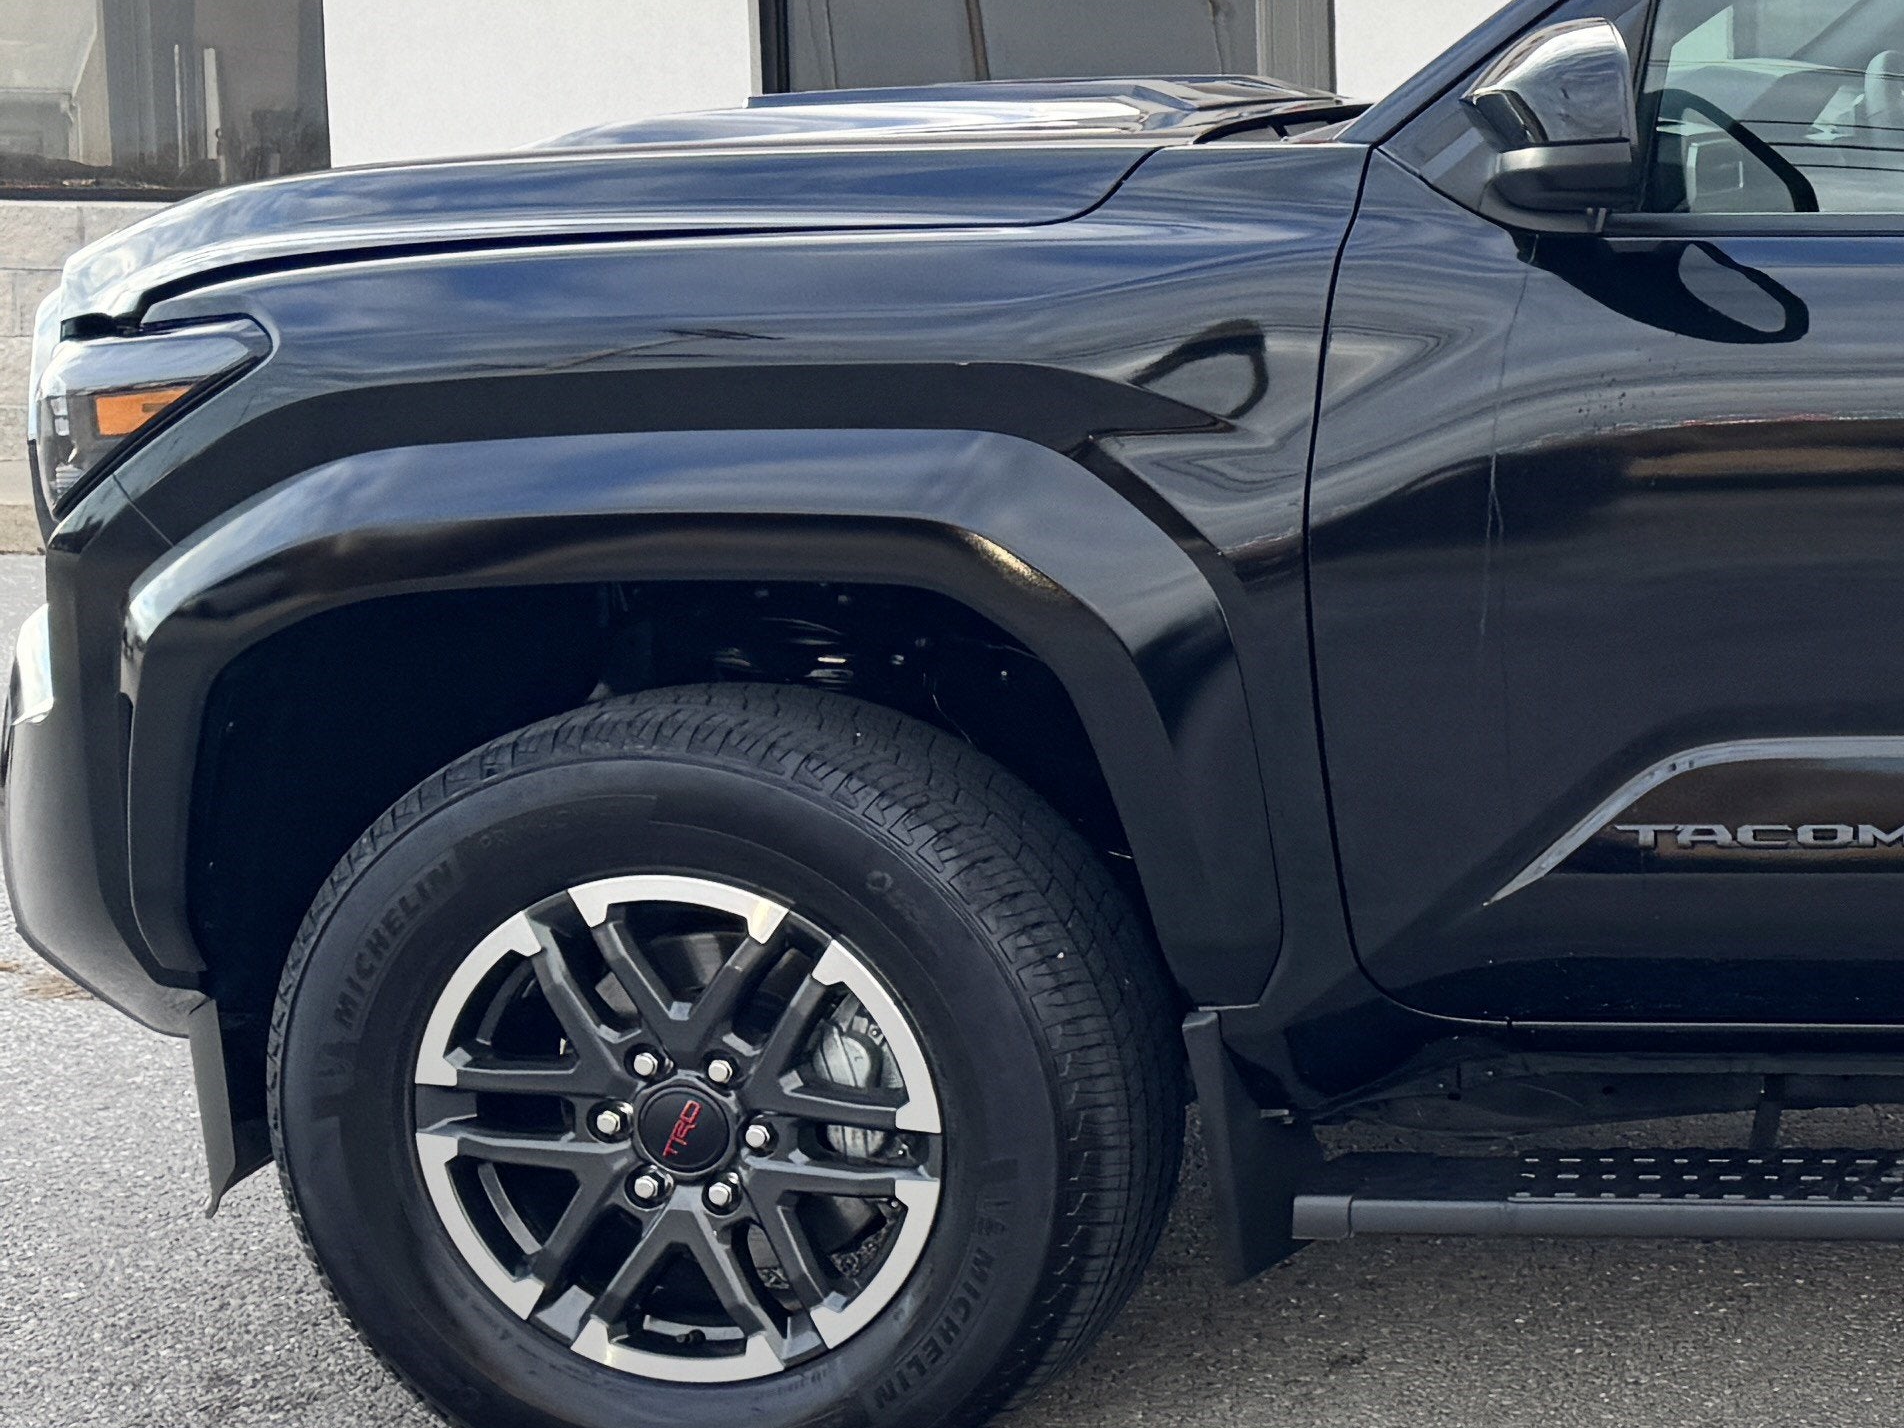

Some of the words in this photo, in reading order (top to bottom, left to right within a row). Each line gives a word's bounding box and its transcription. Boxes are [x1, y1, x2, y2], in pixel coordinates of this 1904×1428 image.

[332, 858, 456, 1030] MICHELIN
[663, 1100, 703, 1158] TRD
[872, 1243, 996, 1411] MICHELIN
